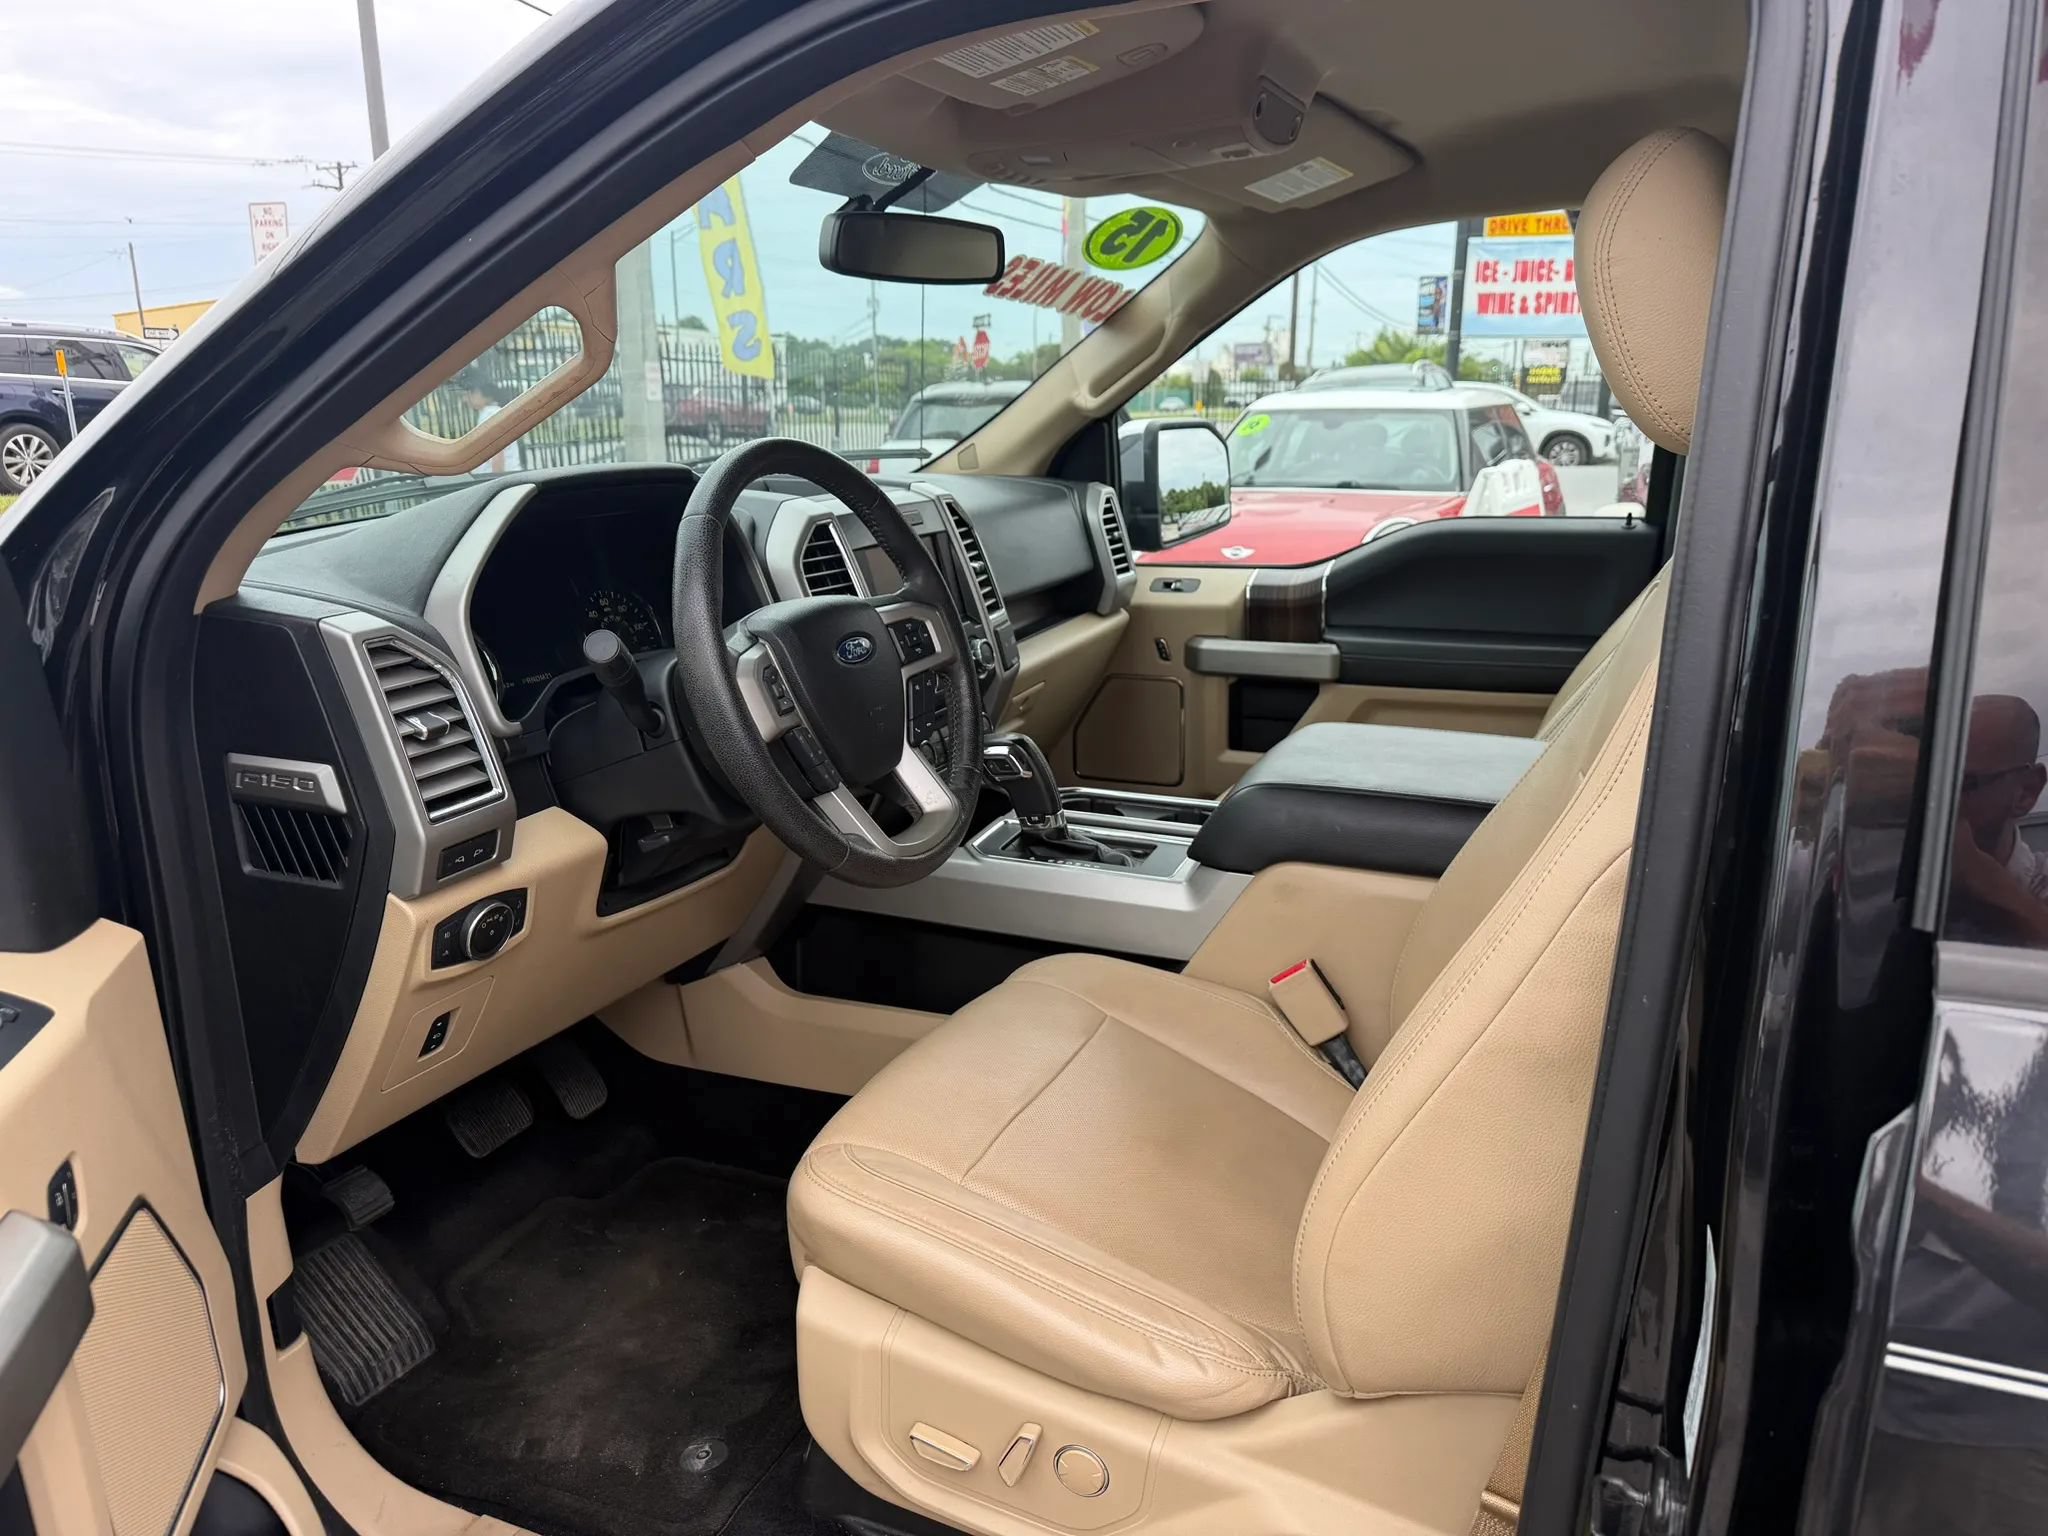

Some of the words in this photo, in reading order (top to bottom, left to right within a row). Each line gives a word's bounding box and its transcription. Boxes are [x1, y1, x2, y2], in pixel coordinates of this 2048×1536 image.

[262, 207, 272, 215] NO
[255, 219, 284, 228] PARKING
[1489, 218, 1528, 234] DRIVE
[1475, 260, 1501, 283] ICE
[1477, 291, 1515, 315] WINE
[1519, 295, 1530, 315] &
